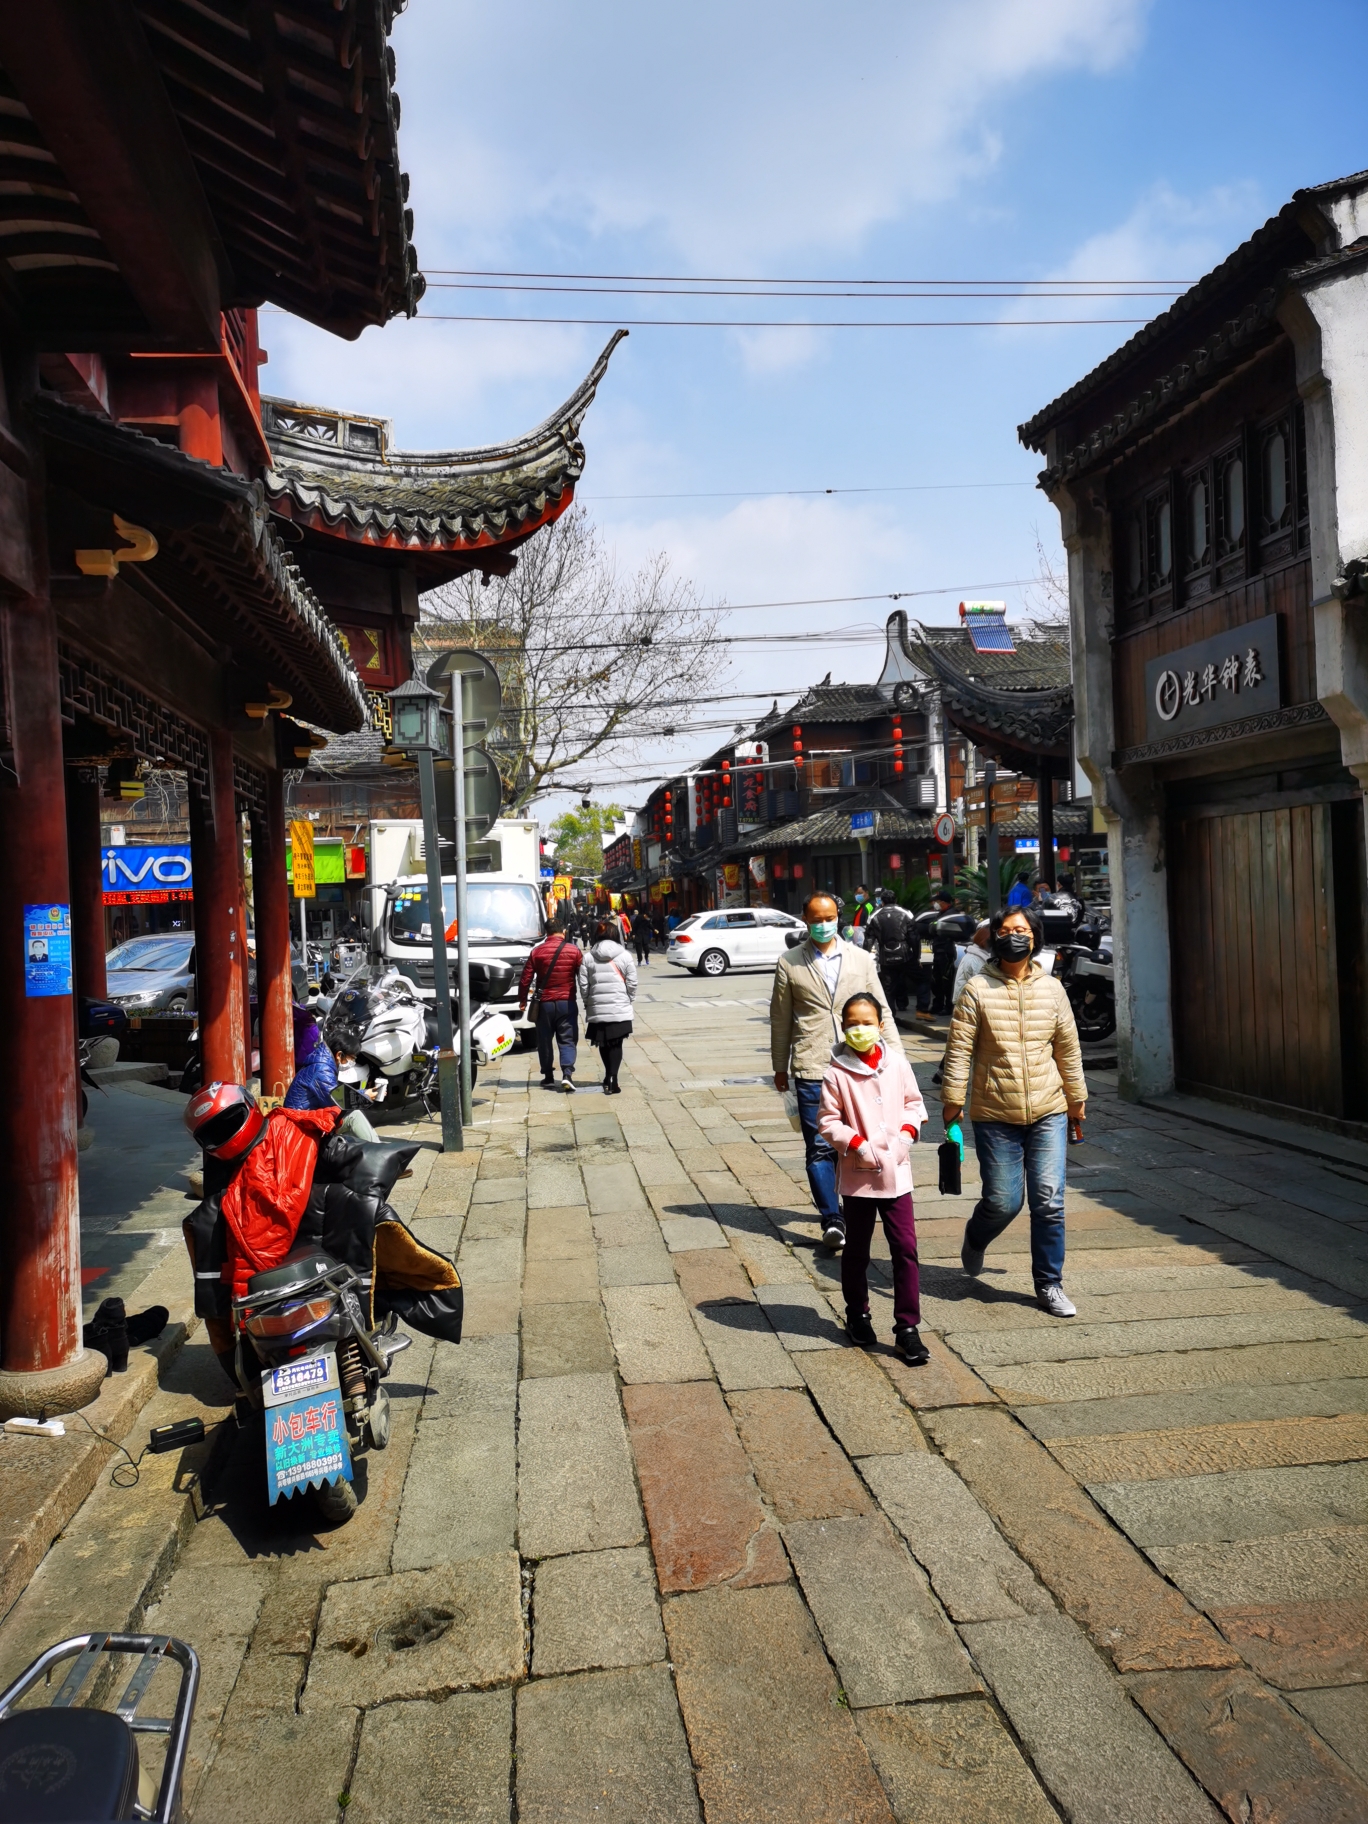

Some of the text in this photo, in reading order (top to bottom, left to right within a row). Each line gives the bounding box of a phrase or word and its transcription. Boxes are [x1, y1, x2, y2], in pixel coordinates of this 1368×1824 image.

[1182, 648, 1262, 706] 光华钟表
[272, 1401, 337, 1444] 小包车行
[274, 1429, 340, 1461] 新大洲专卖
[275, 1443, 341, 1471] 以旧换新 专业维修
